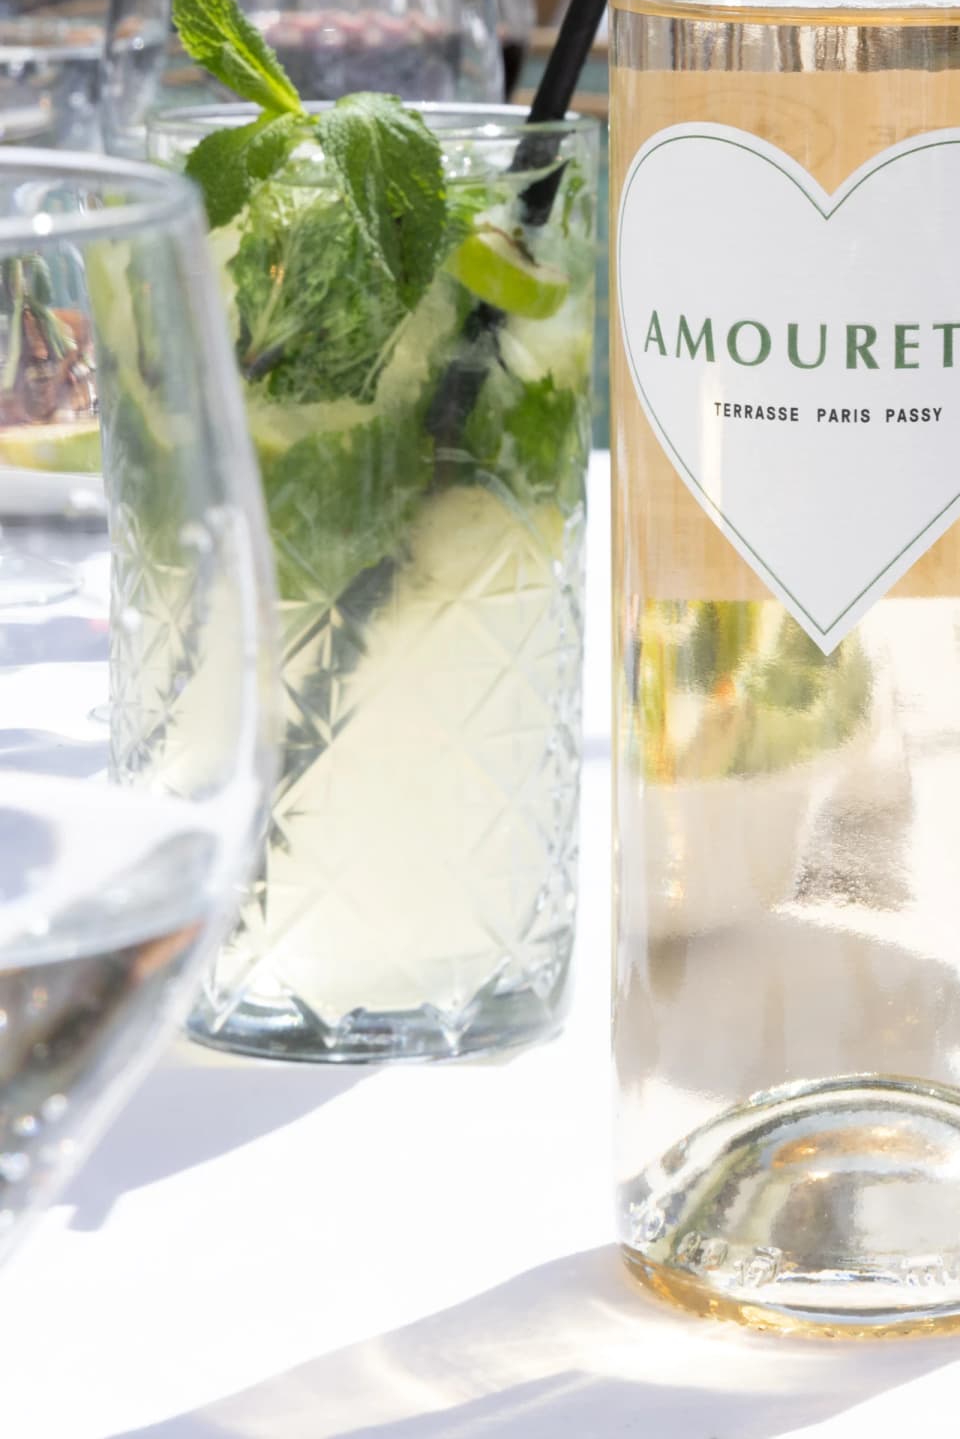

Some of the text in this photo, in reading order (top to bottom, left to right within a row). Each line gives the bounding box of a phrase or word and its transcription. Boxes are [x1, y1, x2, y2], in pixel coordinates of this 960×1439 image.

[713, 402, 943, 423] TERRASSE PARIS PASSY
